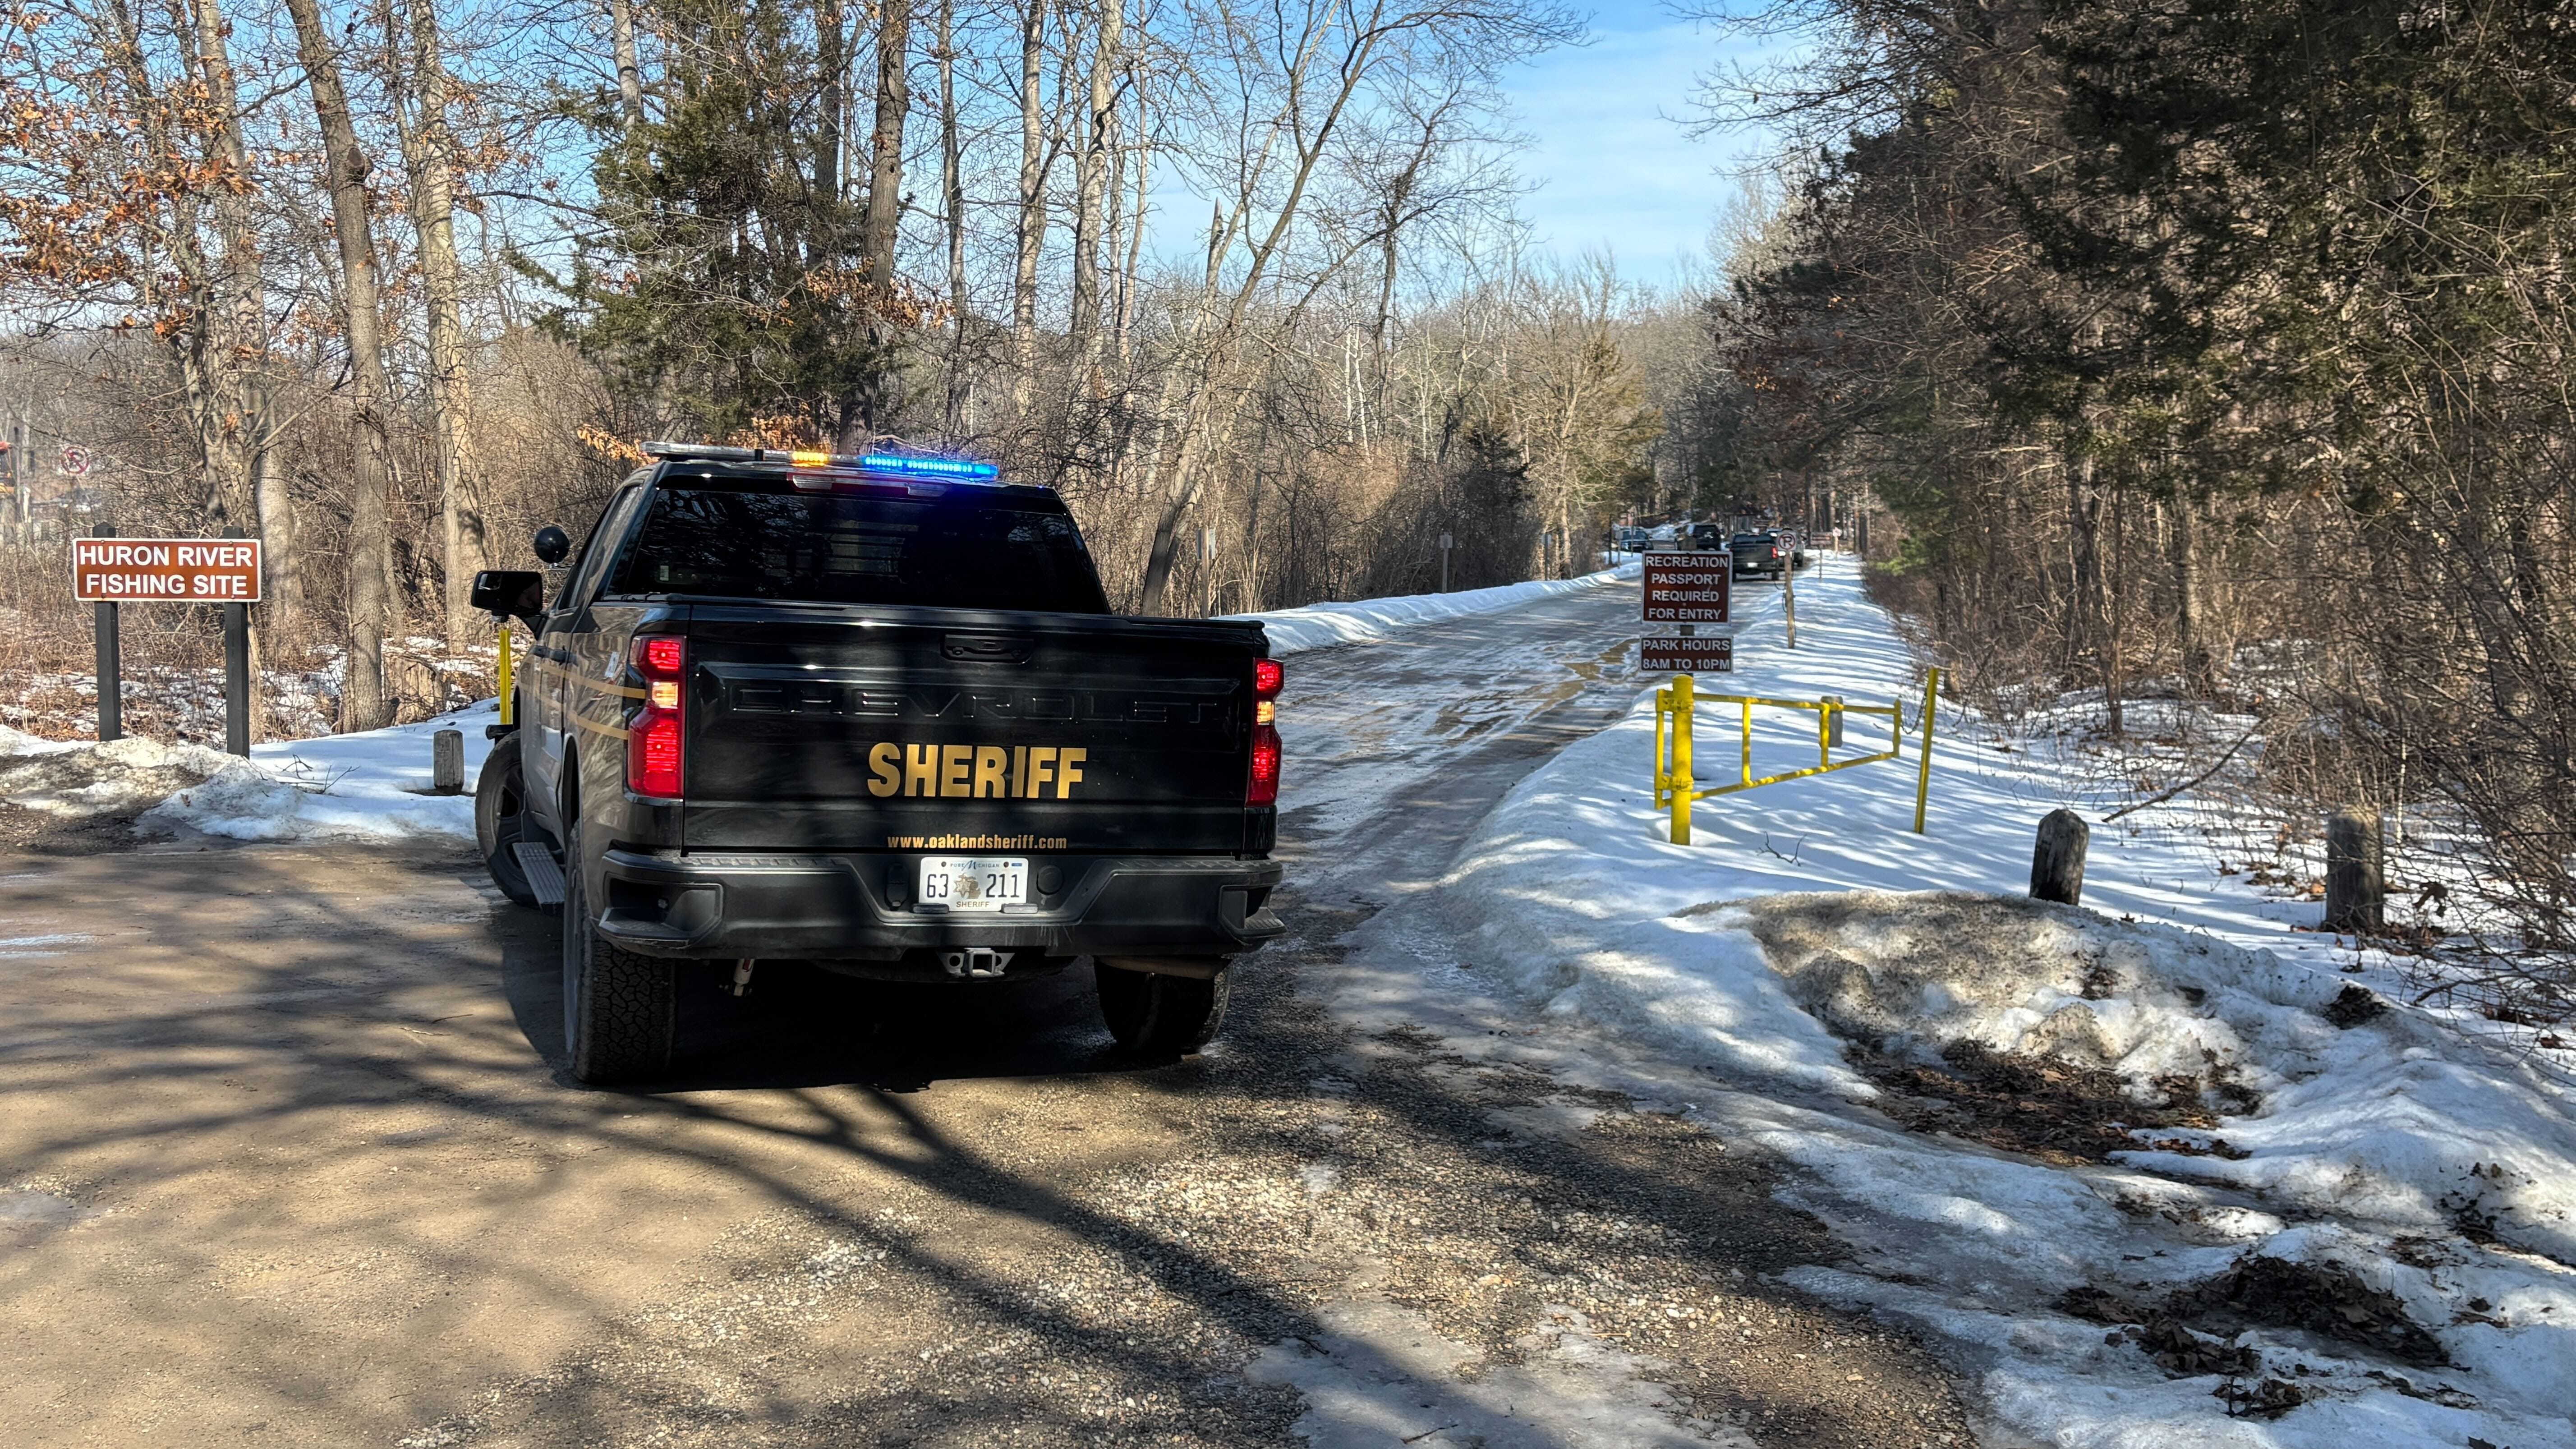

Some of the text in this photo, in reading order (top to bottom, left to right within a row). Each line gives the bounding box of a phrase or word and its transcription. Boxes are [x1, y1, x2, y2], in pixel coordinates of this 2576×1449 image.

[80, 546, 253, 567] HURON RIVER
[1646, 556, 1728, 567] RECREATION
[86, 574, 248, 595] FISHING SITE
[1651, 573, 1721, 585] PASSPORT
[1652, 590, 1719, 602] REQUIRED
[1649, 608, 1721, 620] FOR ENTRY
[1642, 639, 1730, 651] PARK HOURS
[1643, 658, 1730, 670] 8AM TO 10PM
[730, 685, 1218, 723] CHEVROLET
[868, 742, 1086, 799] SHERIFF
[888, 834, 1067, 849] www.oaklandsheriff.com
[927, 874, 1020, 898] 63 211
